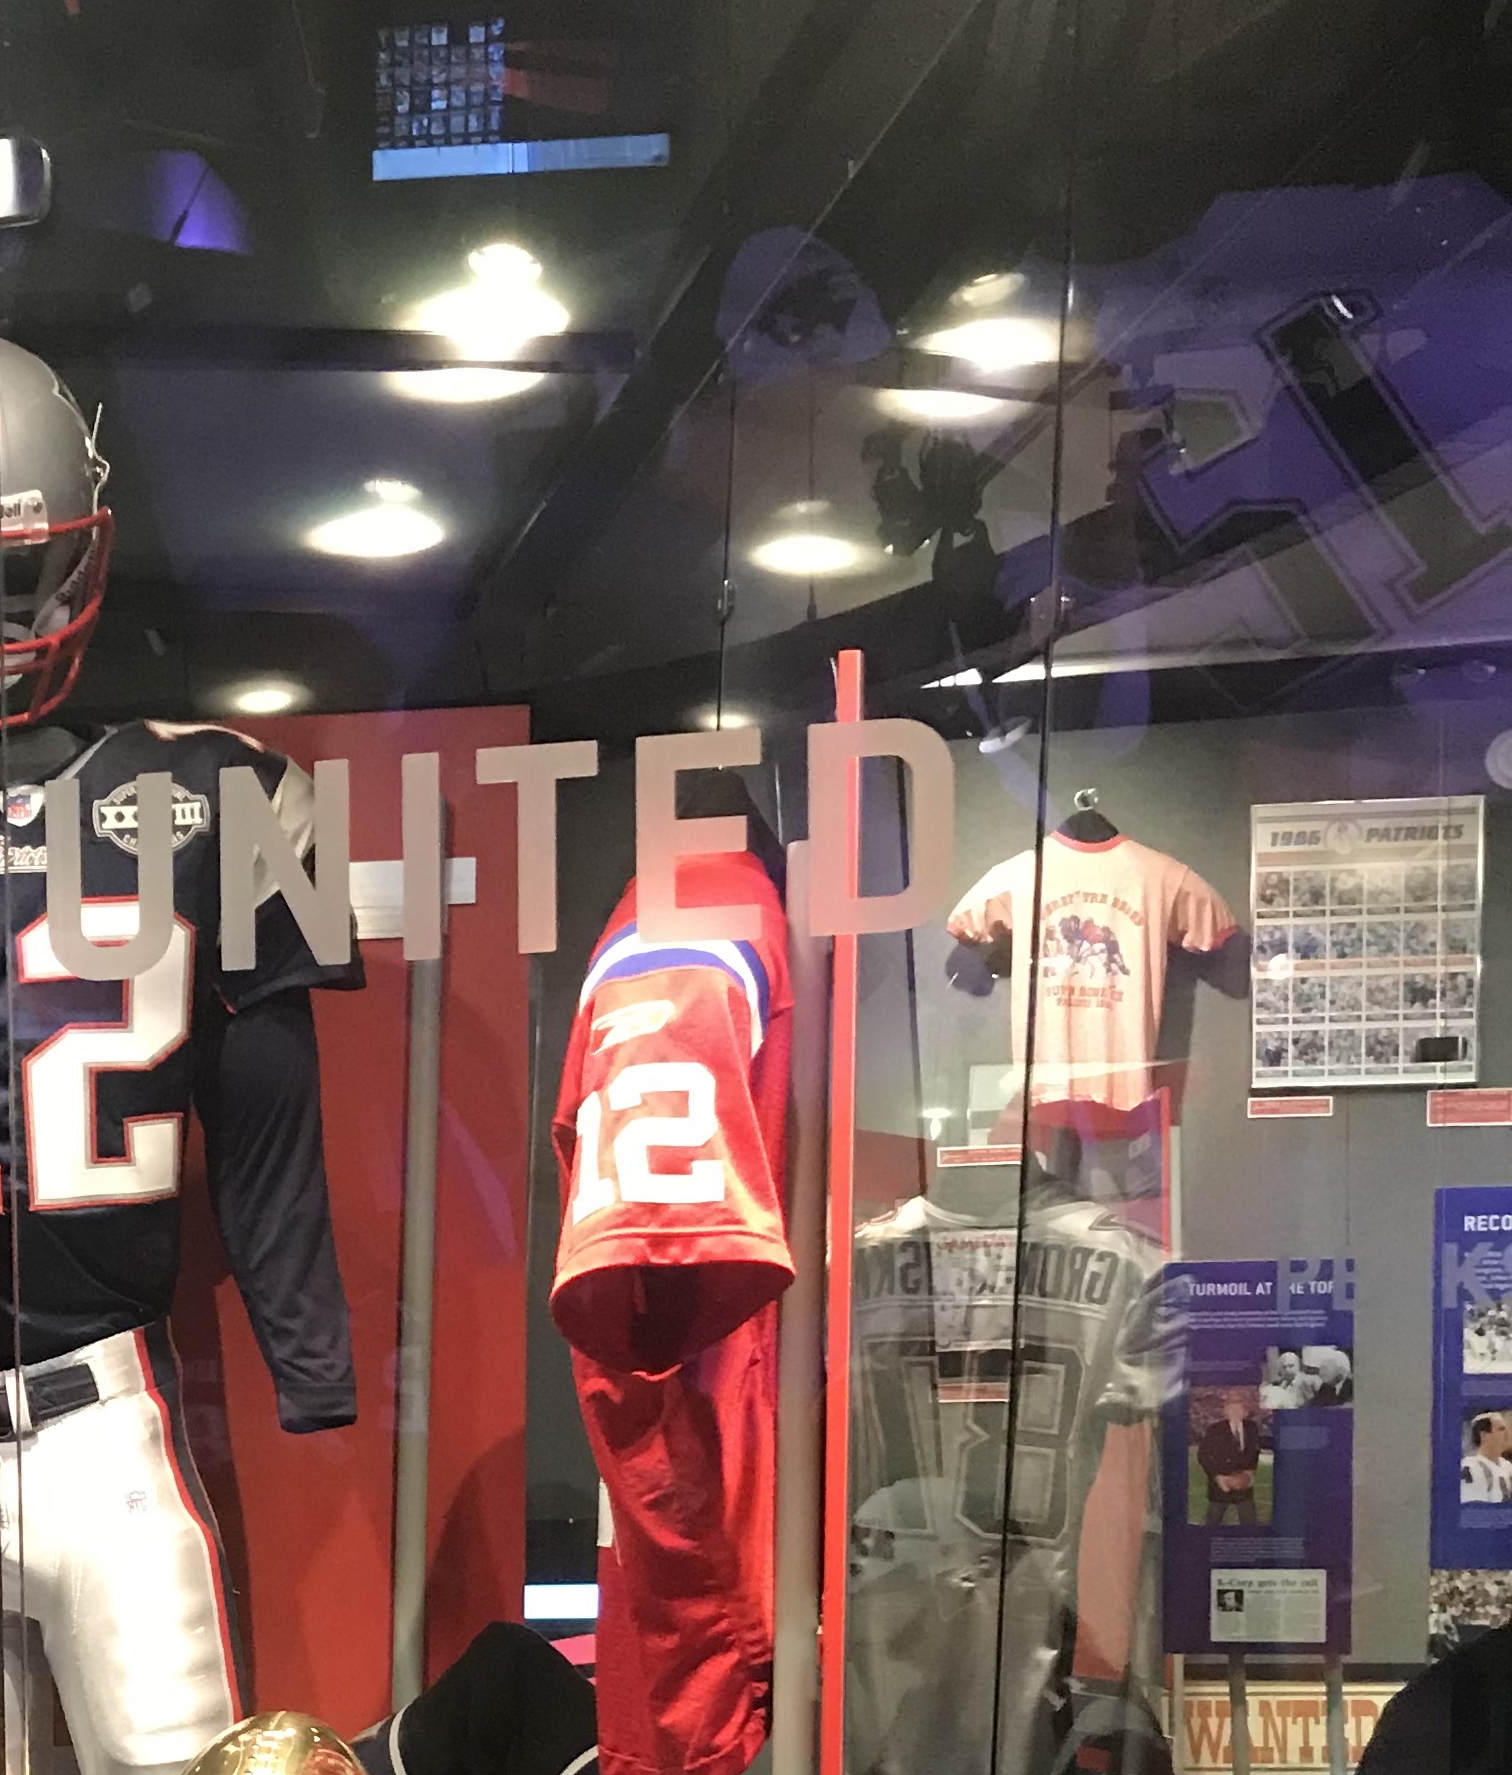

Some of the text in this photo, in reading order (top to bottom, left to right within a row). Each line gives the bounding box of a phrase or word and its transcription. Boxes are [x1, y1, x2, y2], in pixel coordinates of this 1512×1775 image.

[46, 717, 954, 981] UNITED
[1364, 824, 1465, 844] PATRIOTS
[572, 1061, 725, 1226] 12
[1188, 1281, 1252, 1296] TURMOIL
[1255, 1282, 1273, 1295] AT
